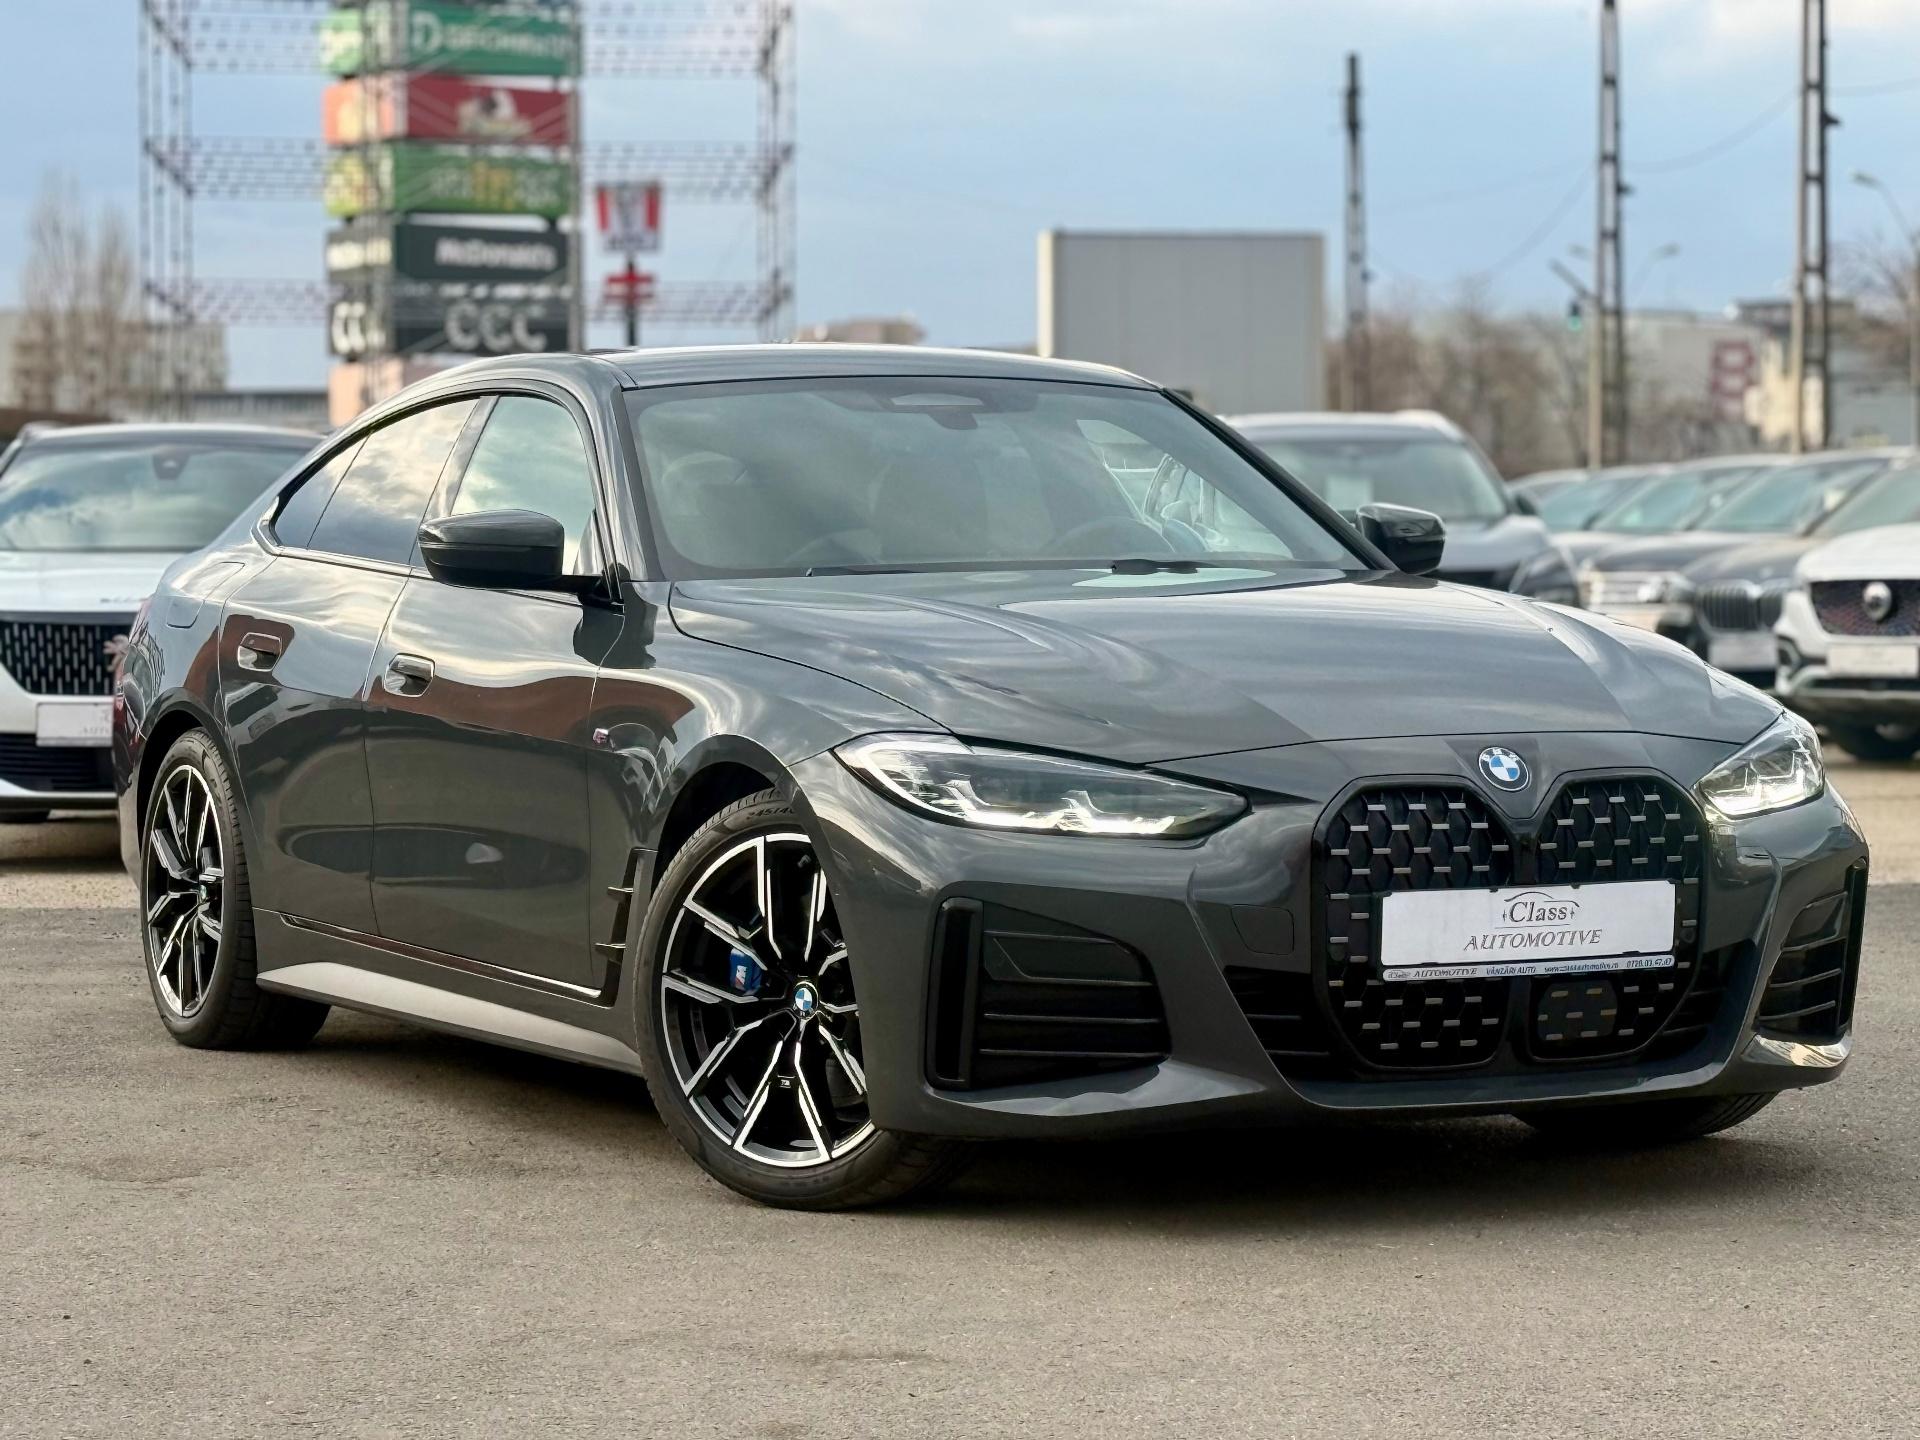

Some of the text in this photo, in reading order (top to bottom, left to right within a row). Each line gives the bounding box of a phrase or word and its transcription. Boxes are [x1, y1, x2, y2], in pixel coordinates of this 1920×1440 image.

[445, 301, 549, 352] CCC
[1508, 900, 1569, 923] Class
[1463, 928, 1603, 952] AUTOMOTIVE
